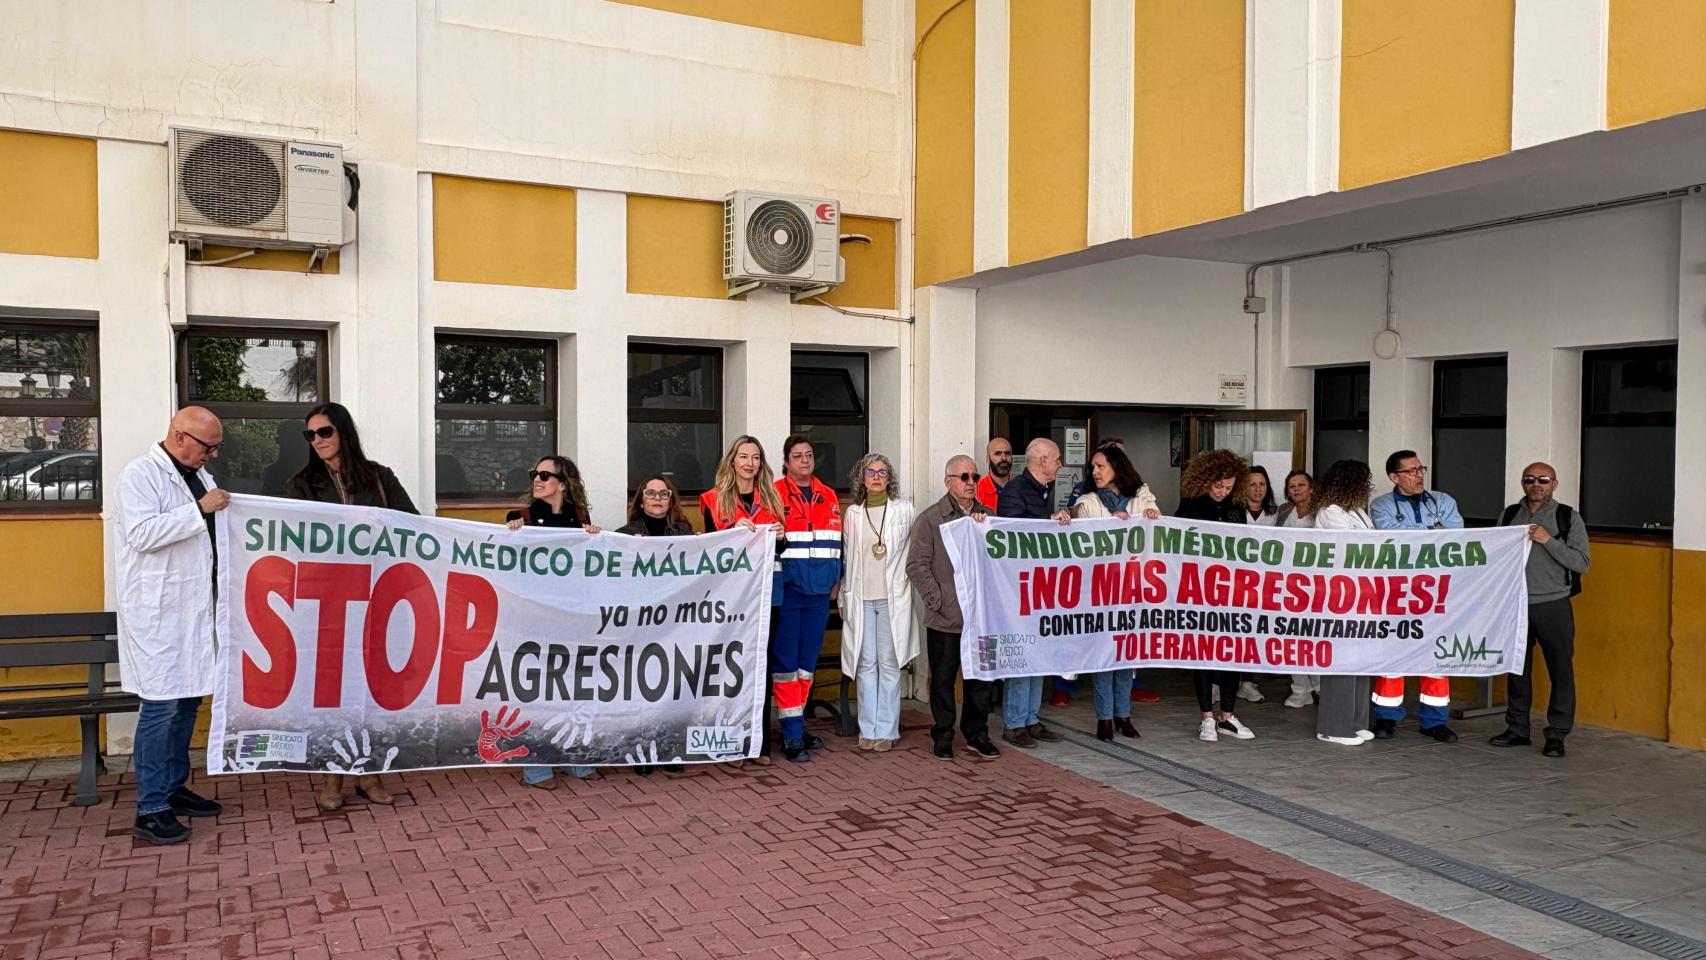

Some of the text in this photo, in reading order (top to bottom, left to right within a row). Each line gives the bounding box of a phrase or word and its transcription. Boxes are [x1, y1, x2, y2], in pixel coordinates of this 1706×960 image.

[291, 148, 335, 159] Panasonic
[245, 518, 753, 577] SINDICATO MÉDICO DE MÁLAGA
[985, 525, 1488, 570] SINDICATO MÉDICO DE MÁLAGA
[1019, 556, 1452, 616] ¡NO MÁS AGRESIONES!
[596, 590, 745, 635] ya no más...
[1039, 608, 1424, 640] CONTRA LAS AGRESIONES A SANITARIAS-OS
[242, 555, 499, 711] STOP
[999, 633, 1037, 645] SINDICATO
[1113, 632, 1333, 668] TOLERANCIA CERO
[1434, 632, 1488, 663] SMA
[475, 640, 743, 703] AGRESIONES
[691, 728, 729, 750] SMA
